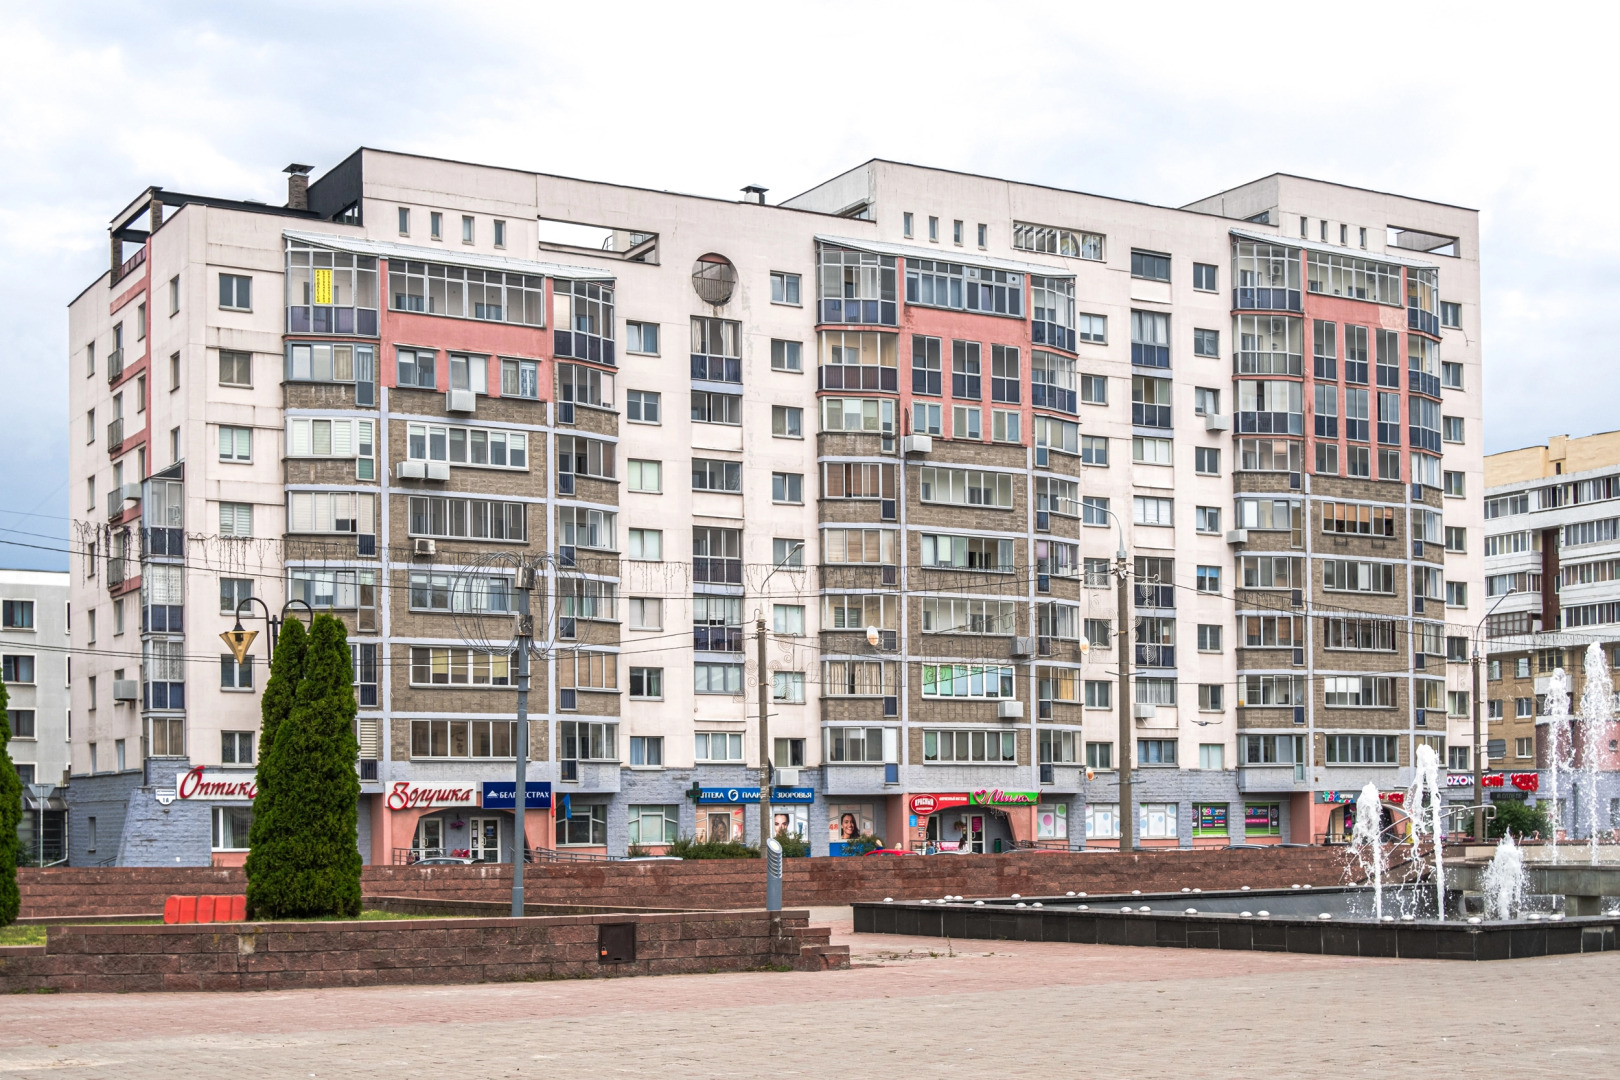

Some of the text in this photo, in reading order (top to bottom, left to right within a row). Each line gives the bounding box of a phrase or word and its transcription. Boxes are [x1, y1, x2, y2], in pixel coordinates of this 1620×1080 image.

[1447, 774, 1475, 786] OZON
[387, 781, 474, 811] Золушка
[499, 791, 550, 799] БЕЛГСТРАХ
[775, 791, 812, 799] ЗДОРОВЬЯ
[985, 788, 1037, 805] Мила
